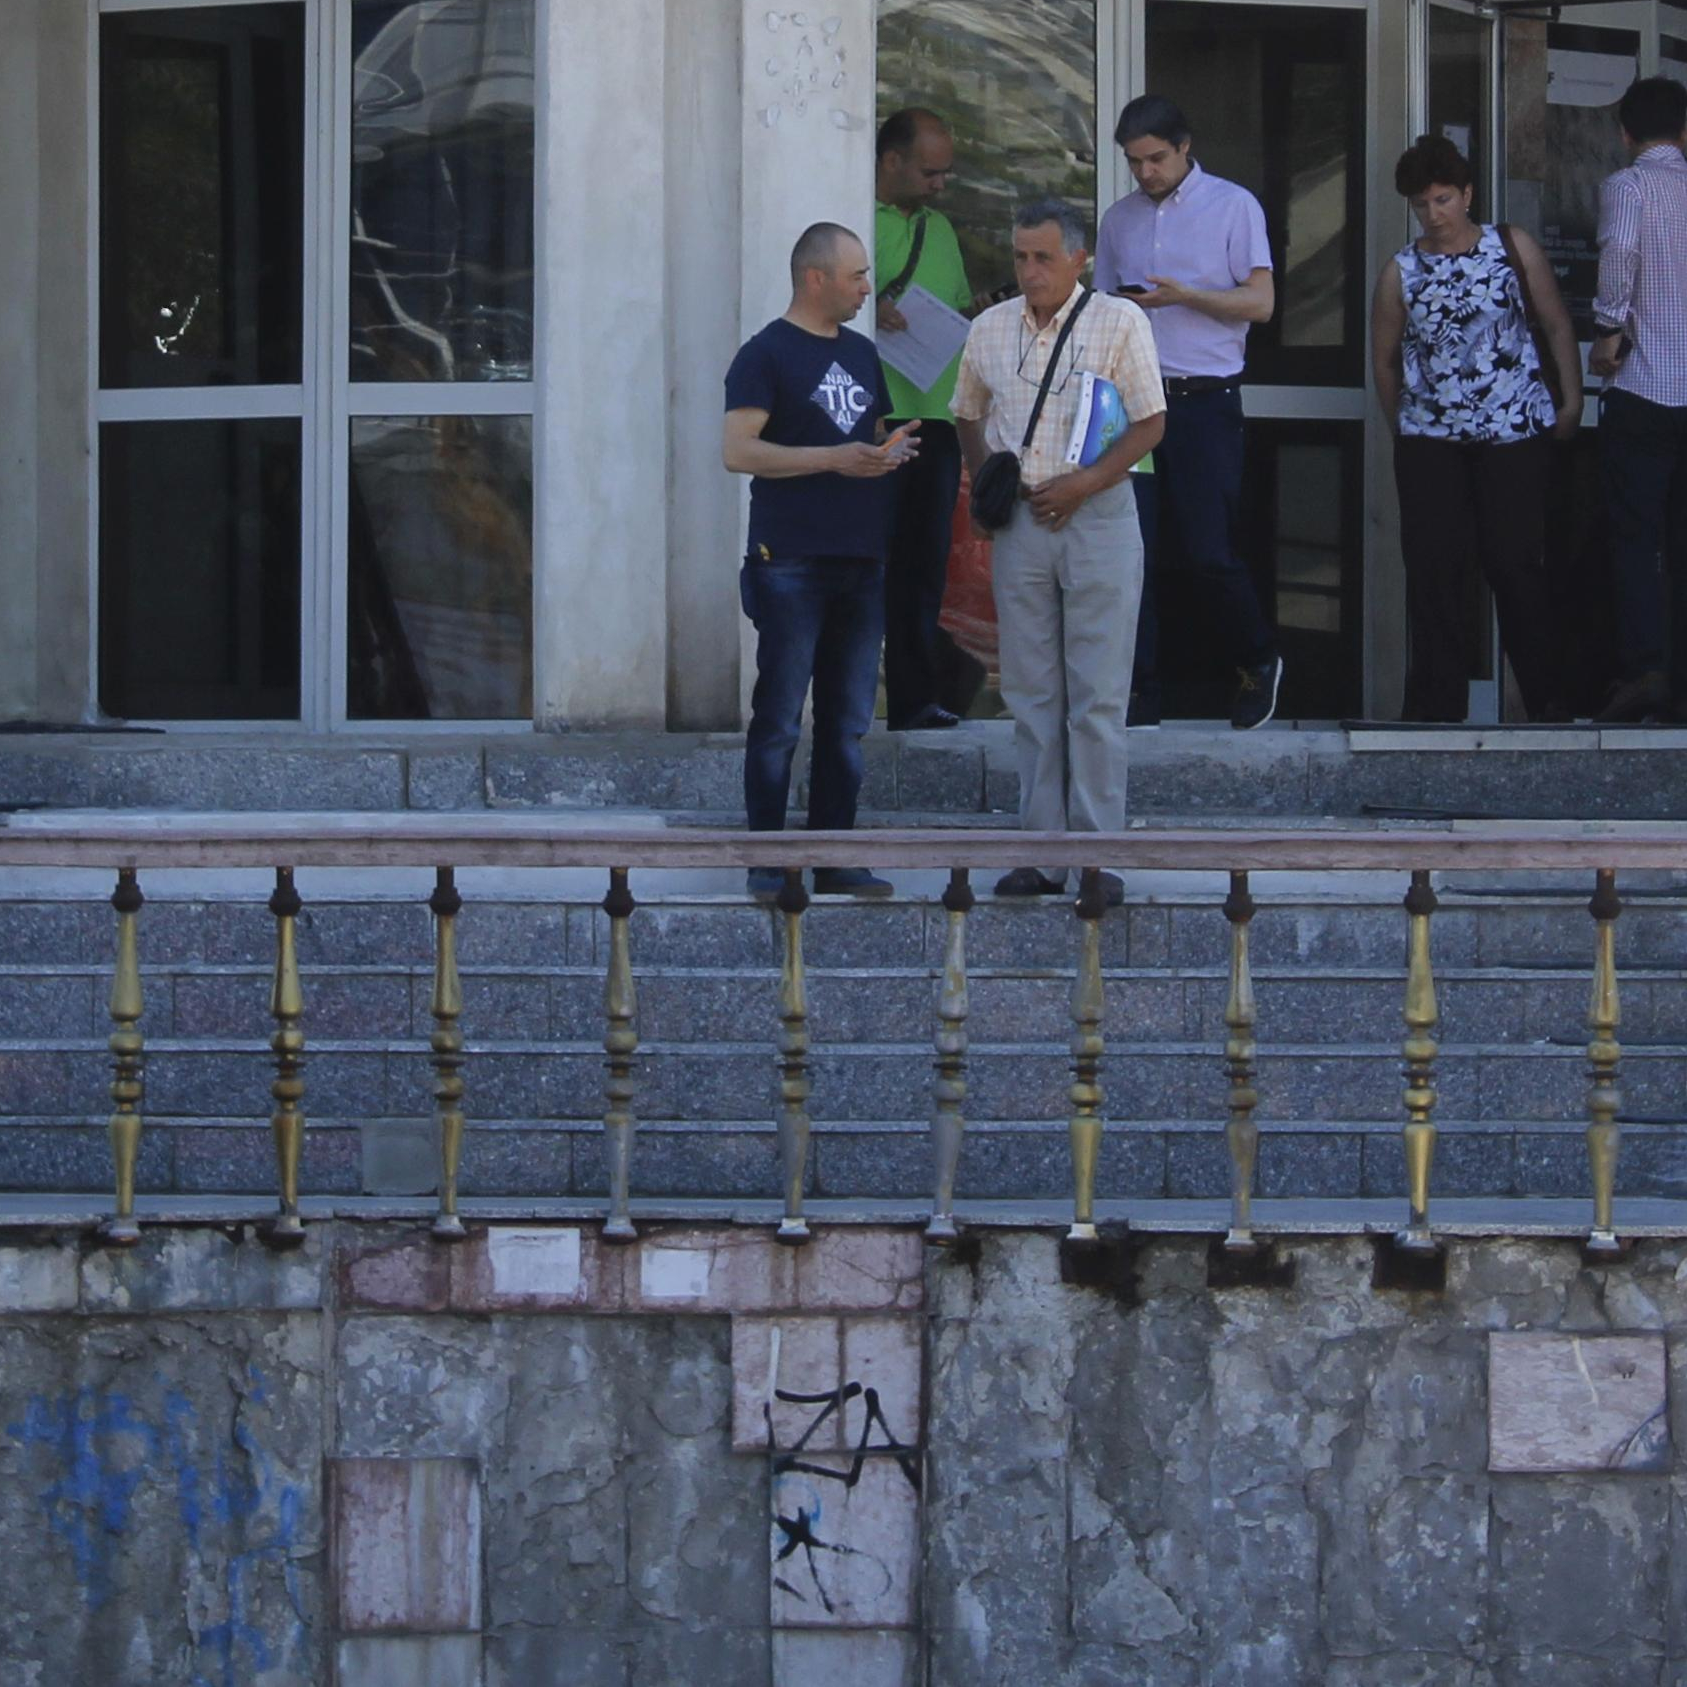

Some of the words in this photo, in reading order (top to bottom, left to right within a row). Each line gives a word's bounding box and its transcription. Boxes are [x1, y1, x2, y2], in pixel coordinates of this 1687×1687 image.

[824, 373, 854, 386] NAU
[818, 384, 867, 413] TIC
[835, 410, 856, 426] AL
